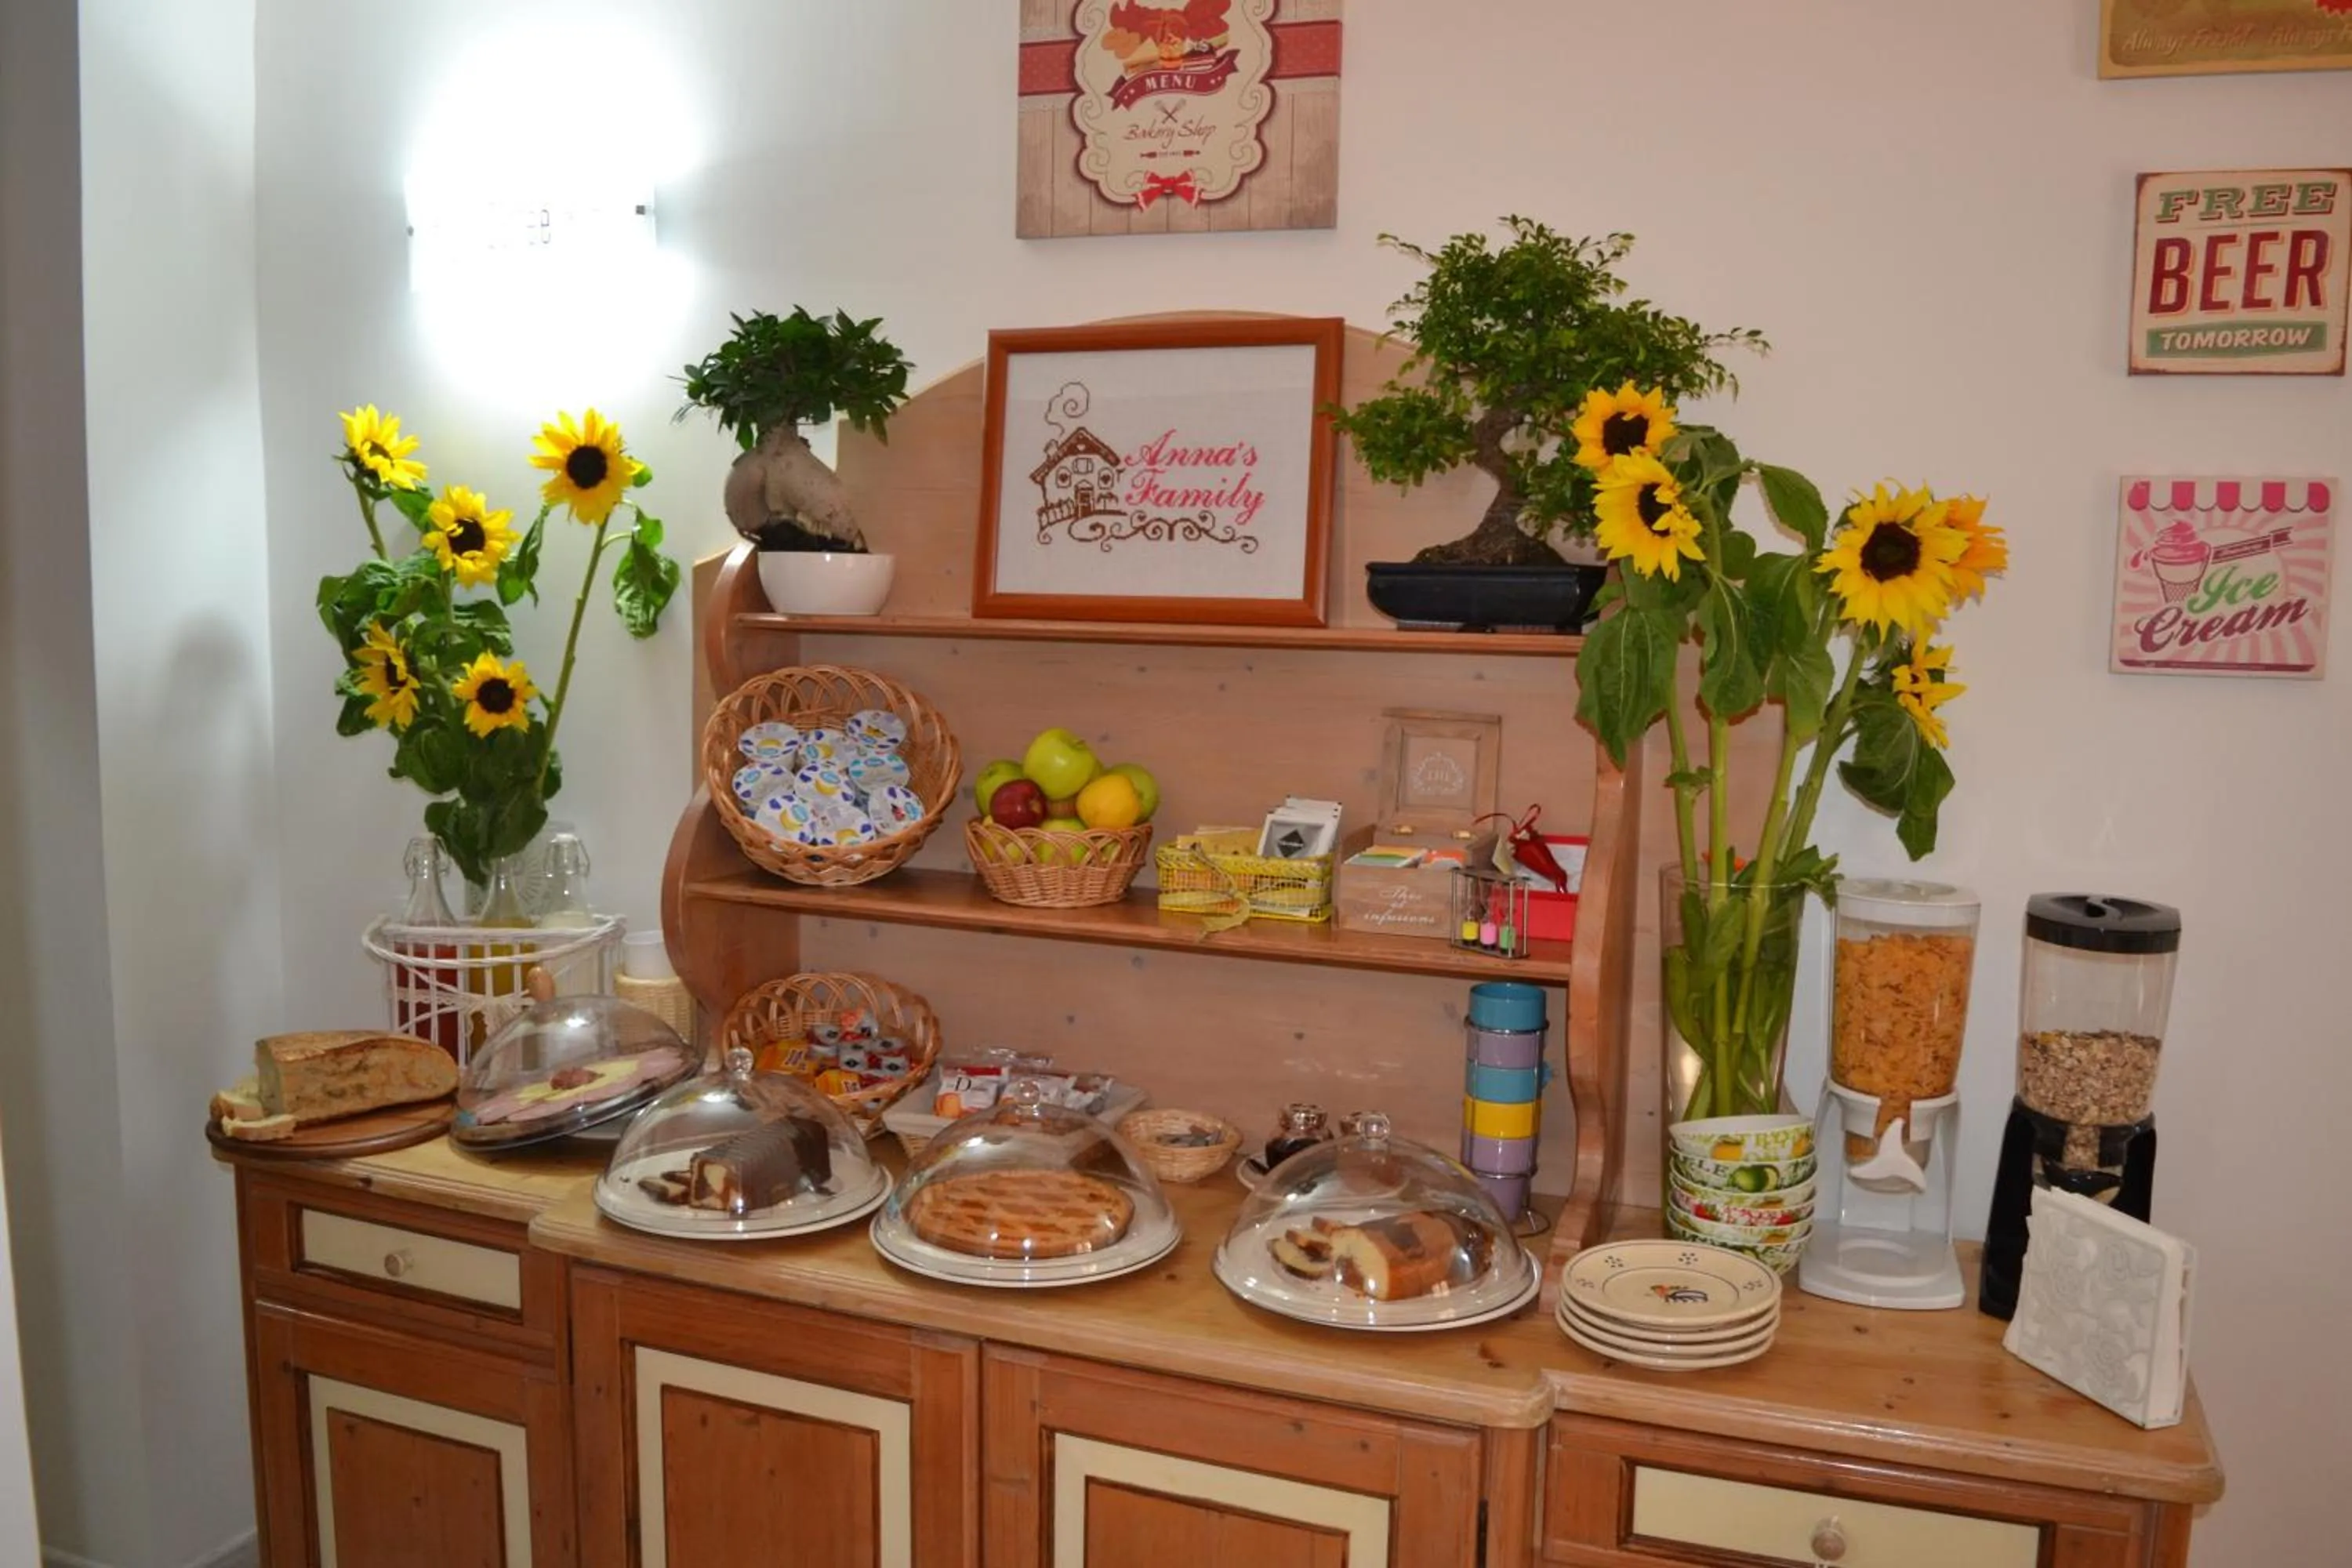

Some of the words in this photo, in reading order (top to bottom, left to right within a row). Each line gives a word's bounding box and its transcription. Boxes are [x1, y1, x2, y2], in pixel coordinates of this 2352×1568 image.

[1145, 74, 1197, 92] MENU
[1123, 118, 1176, 149] Bakery
[1177, 114, 1217, 146] Shop
[2154, 182, 2338, 223] FREE
[2148, 230, 2332, 315] BEER
[2159, 327, 2312, 351] TOMORROW
[1123, 428, 1258, 468] Anna's
[1124, 470, 1266, 526] Family
[2187, 564, 2279, 615] Ice
[2133, 598, 2310, 653] Cream
